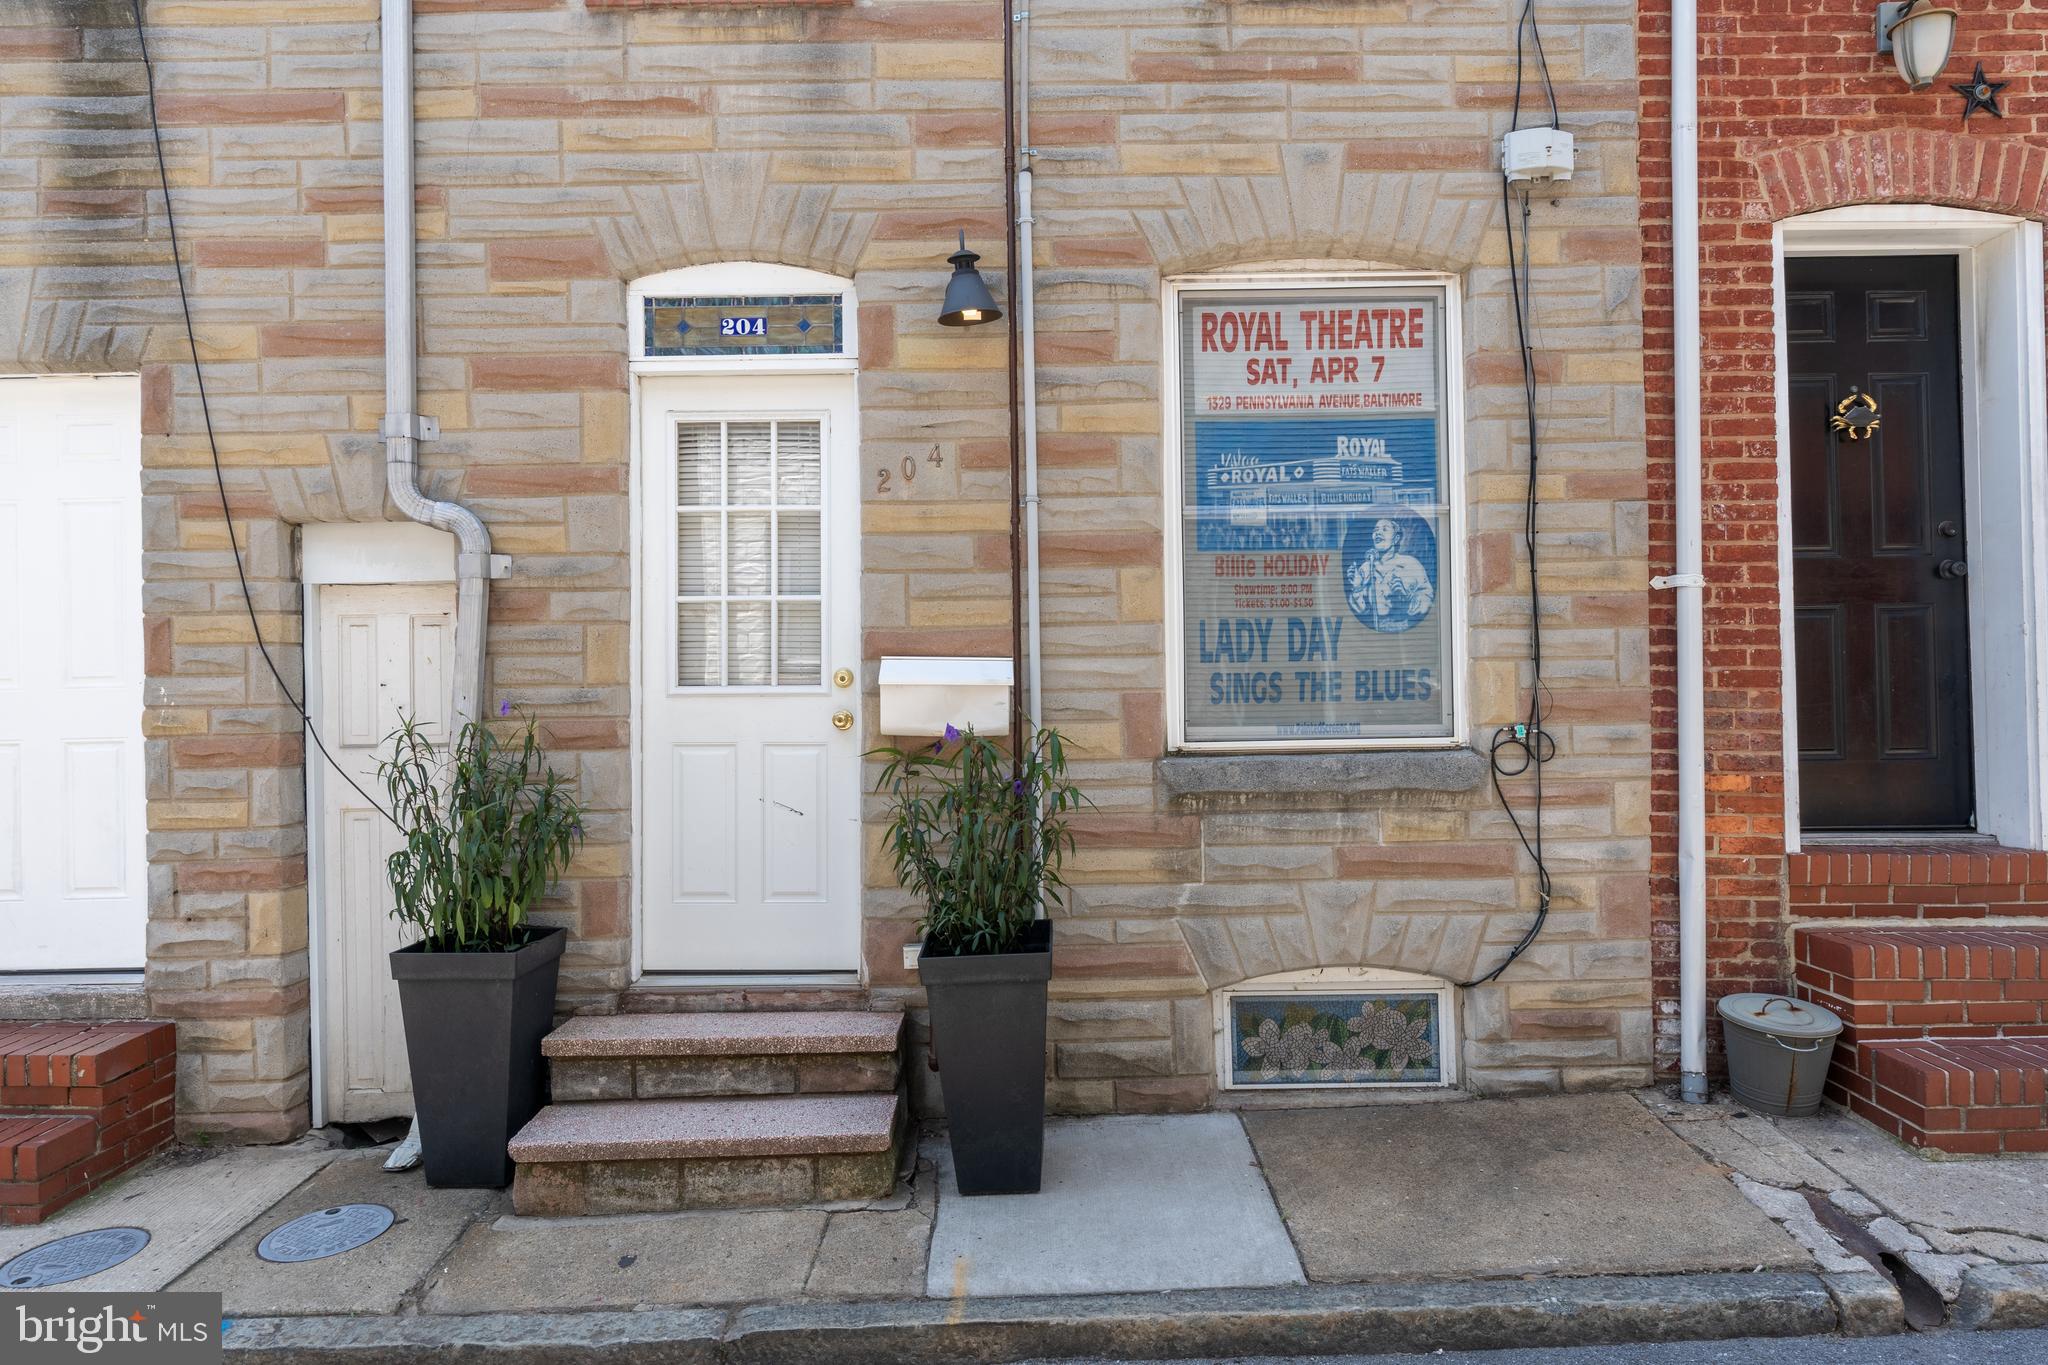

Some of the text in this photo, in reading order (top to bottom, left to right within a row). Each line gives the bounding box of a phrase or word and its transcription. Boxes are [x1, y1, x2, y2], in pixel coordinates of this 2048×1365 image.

[721, 318, 766, 336] 204
[1201, 308, 1424, 353] ROYAL THEATRE
[1246, 355, 1385, 389] SAT, APR 7
[1235, 395, 1315, 410] PENNSYLVANIA
[1336, 435, 1392, 458] ROYAL
[1232, 465, 1291, 483] ROYAL
[1214, 553, 1330, 577] Billie HOLIDAY
[1200, 616, 1344, 664] LADY DAY
[1210, 668, 1432, 705] SINGS THE BLUES
